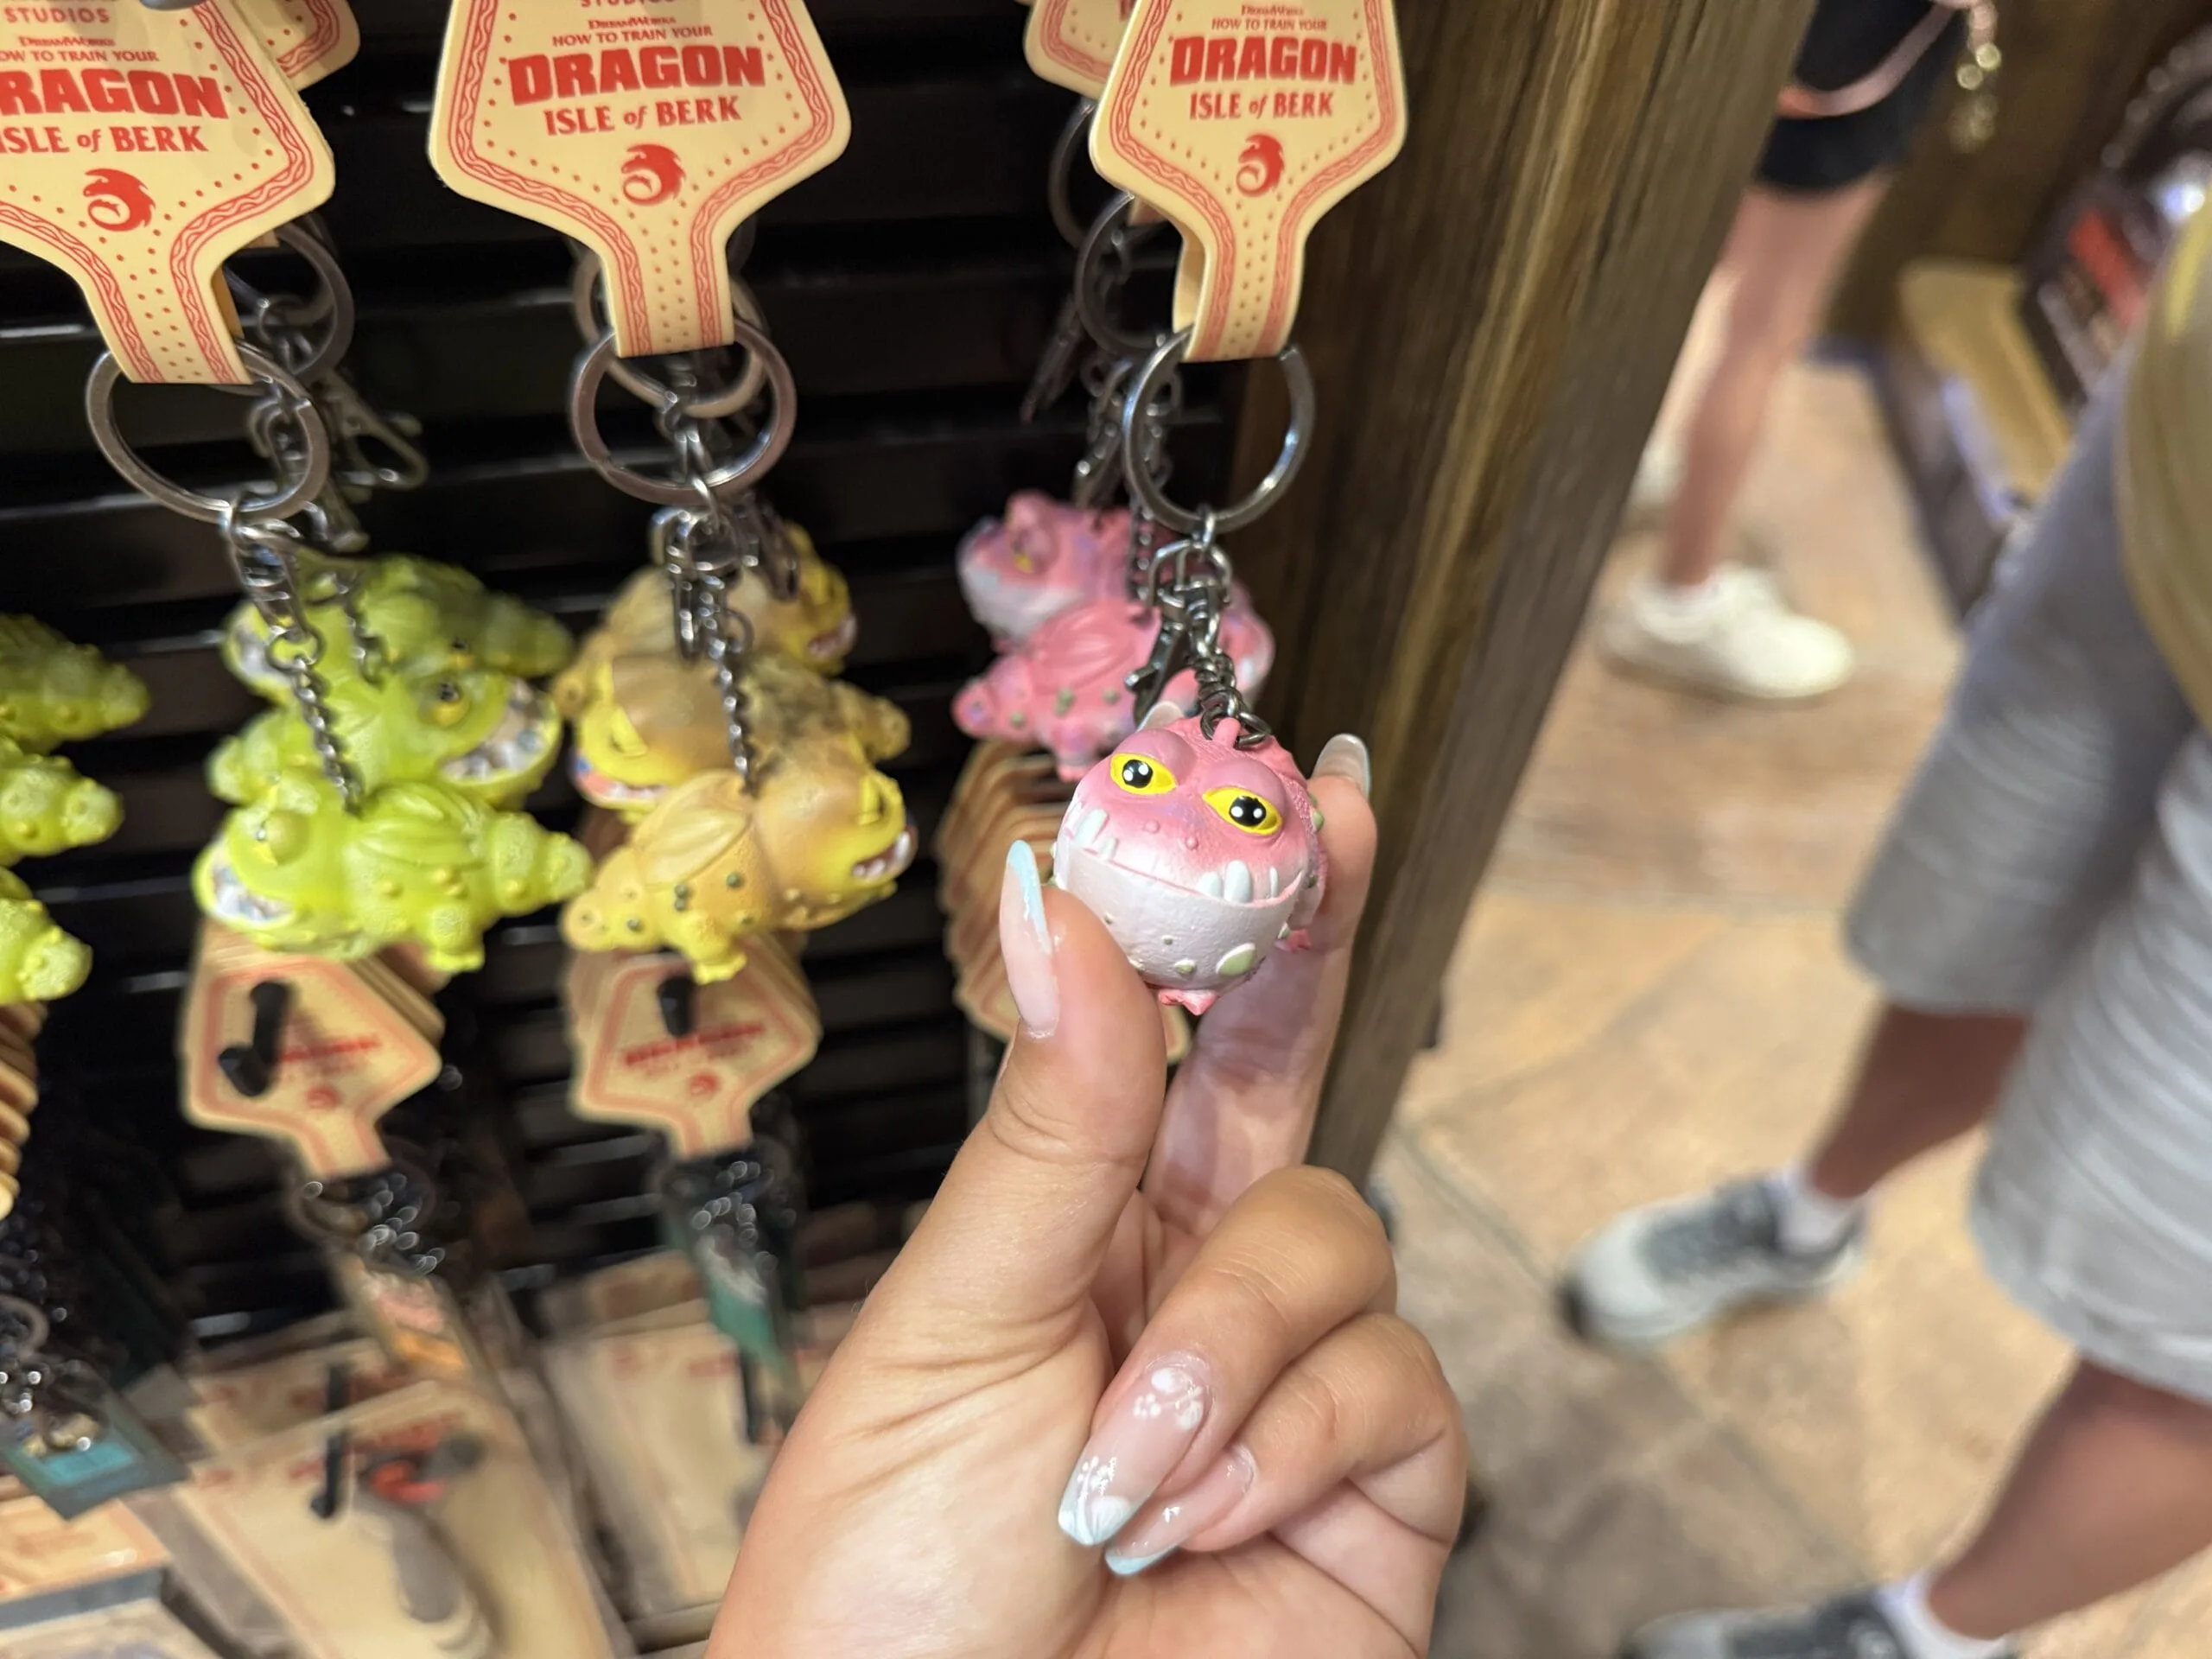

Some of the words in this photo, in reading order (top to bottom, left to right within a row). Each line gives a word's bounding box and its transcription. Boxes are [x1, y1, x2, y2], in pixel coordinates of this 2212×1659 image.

[3, 7, 110, 23] STUDIOS
[1211, 18, 1242, 30] HOW
[1245, 18, 1261, 31] TO
[1263, 18, 1294, 31] TRAIN
[1299, 19, 1327, 31] YOUR
[551, 34, 592, 47] HOW
[596, 32, 618, 43] TO
[621, 29, 667, 42] TRAIN
[671, 25, 713, 38] YOUR
[0, 50, 25, 63] OW
[30, 50, 54, 62] TO
[57, 50, 108, 62] TRAIN
[111, 50, 159, 62] YOUR
[1170, 35, 1357, 86] DRAGON
[508, 45, 766, 105] DRAGON
[0, 68, 229, 119] RAGON
[1189, 92, 1241, 119] ISLE
[1249, 93, 1268, 119] of
[1273, 90, 1333, 119] BERK
[543, 105, 615, 136] ISLE
[623, 105, 648, 130] of
[655, 95, 742, 127] BERK
[76, 129, 101, 153] of
[109, 125, 209, 153] BERK
